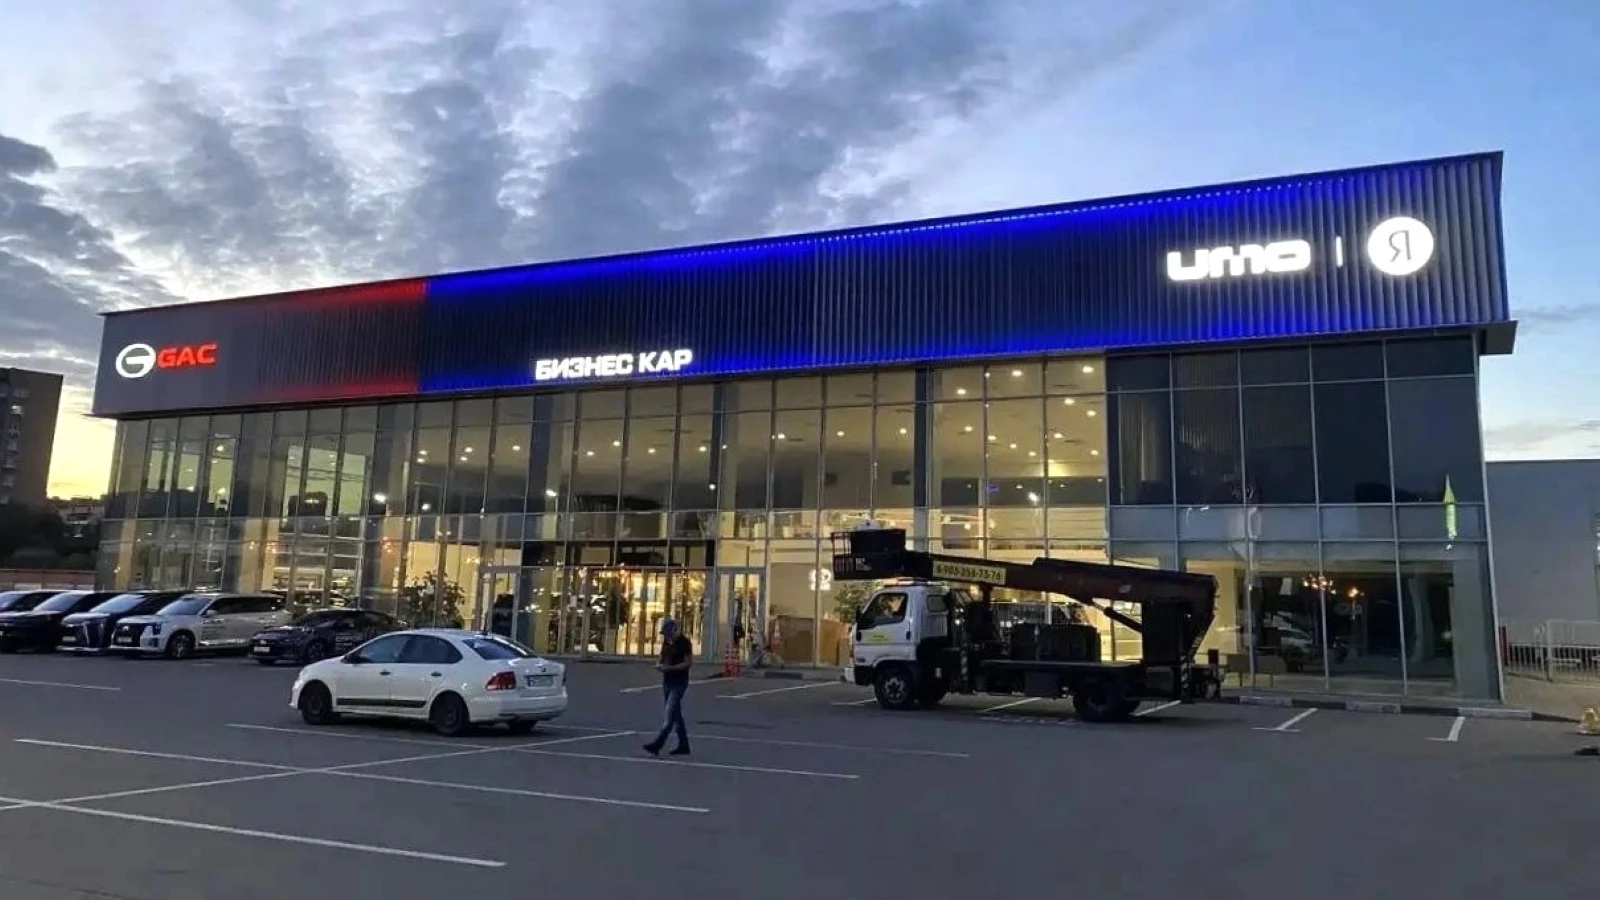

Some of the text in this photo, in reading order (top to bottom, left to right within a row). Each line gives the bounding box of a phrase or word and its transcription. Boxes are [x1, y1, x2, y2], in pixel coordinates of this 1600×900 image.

[157, 344, 217, 369] GAC
[535, 349, 693, 380] БИЗНЕС КАР
